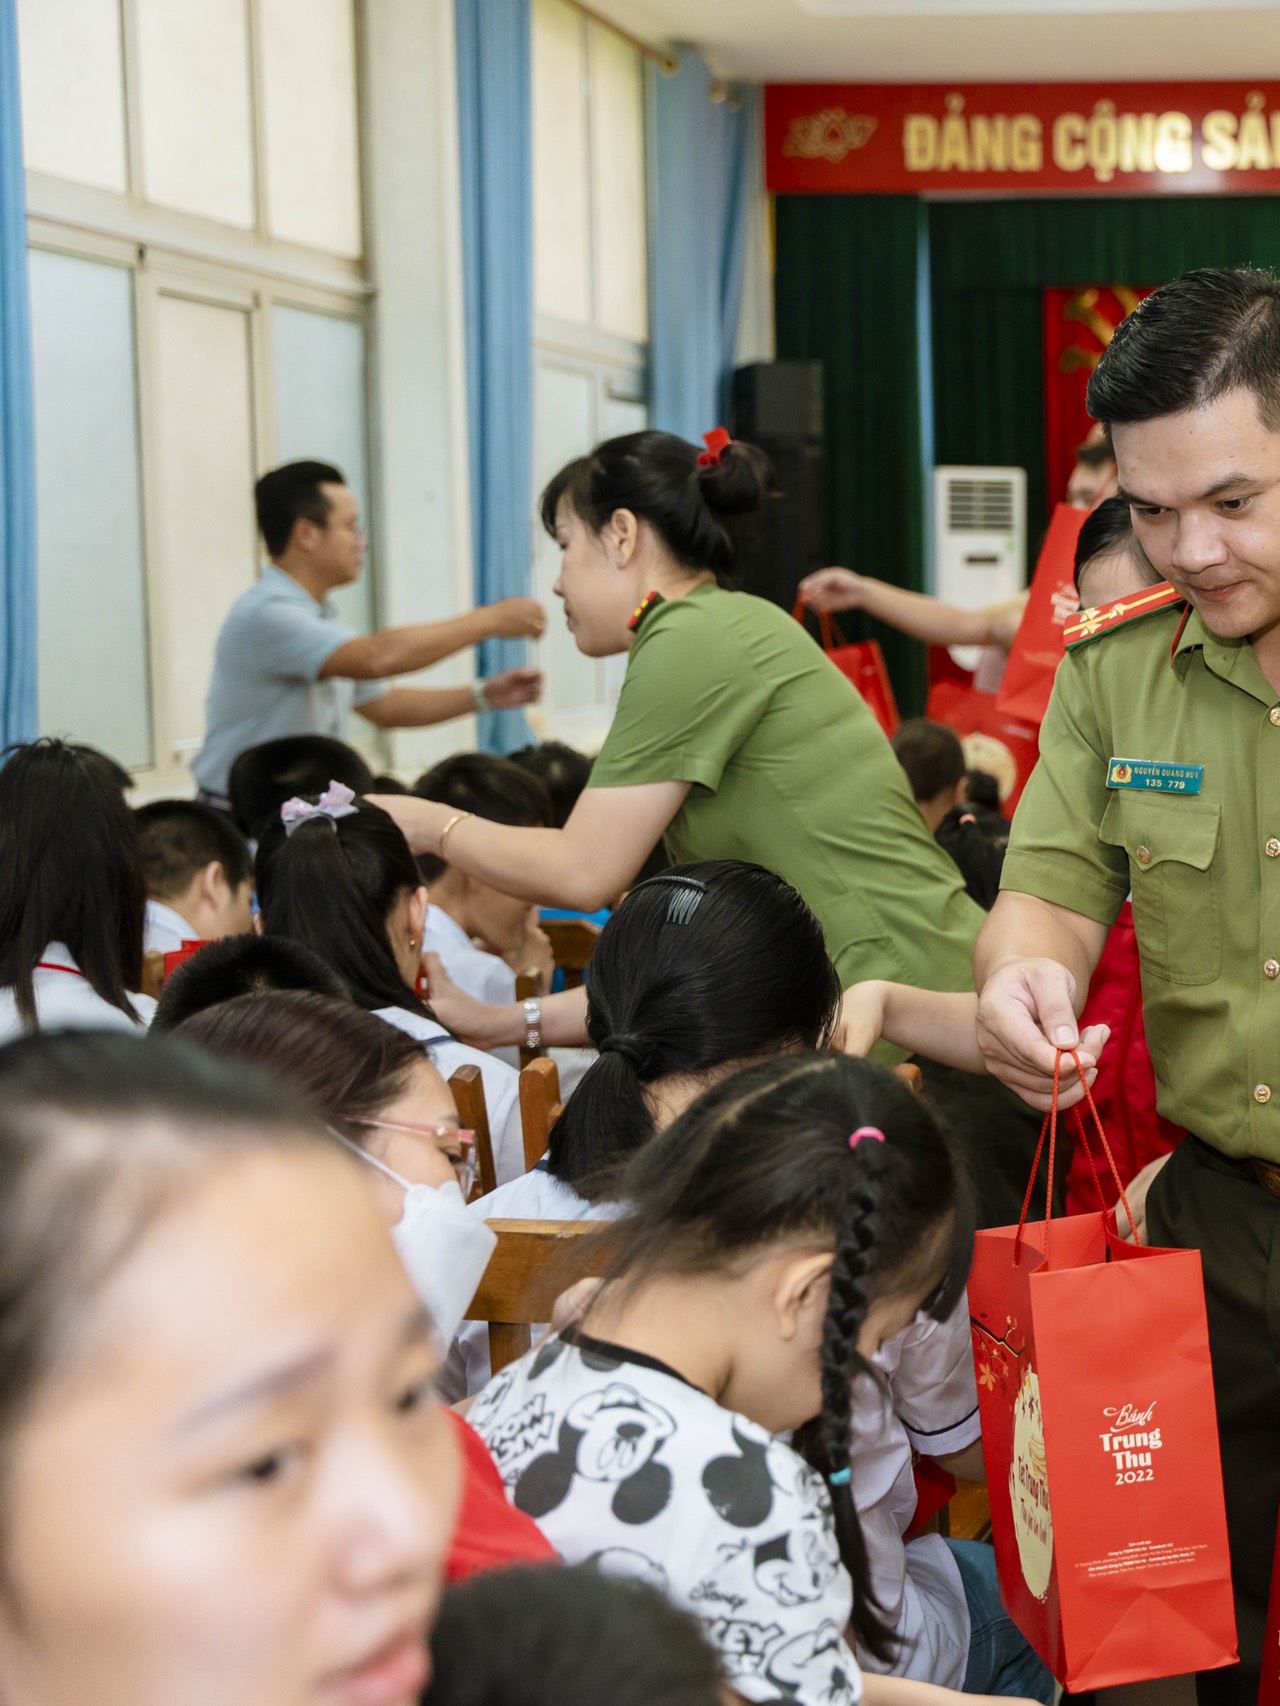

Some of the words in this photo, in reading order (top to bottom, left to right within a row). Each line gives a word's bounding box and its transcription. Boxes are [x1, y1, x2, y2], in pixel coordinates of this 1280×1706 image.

[903, 91, 1043, 173] ĐẢNG
[1052, 98, 1193, 182] CỘNG
[1161, 768, 1184, 778] QUANG
[1145, 778, 1162, 787] 135
[1168, 780, 1186, 789] 779
[1103, 1400, 1157, 1432] Bánh
[1099, 1428, 1163, 1451] Trung
[1112, 1450, 1152, 1470] Thu
[1115, 1468, 1154, 1486] 2022
